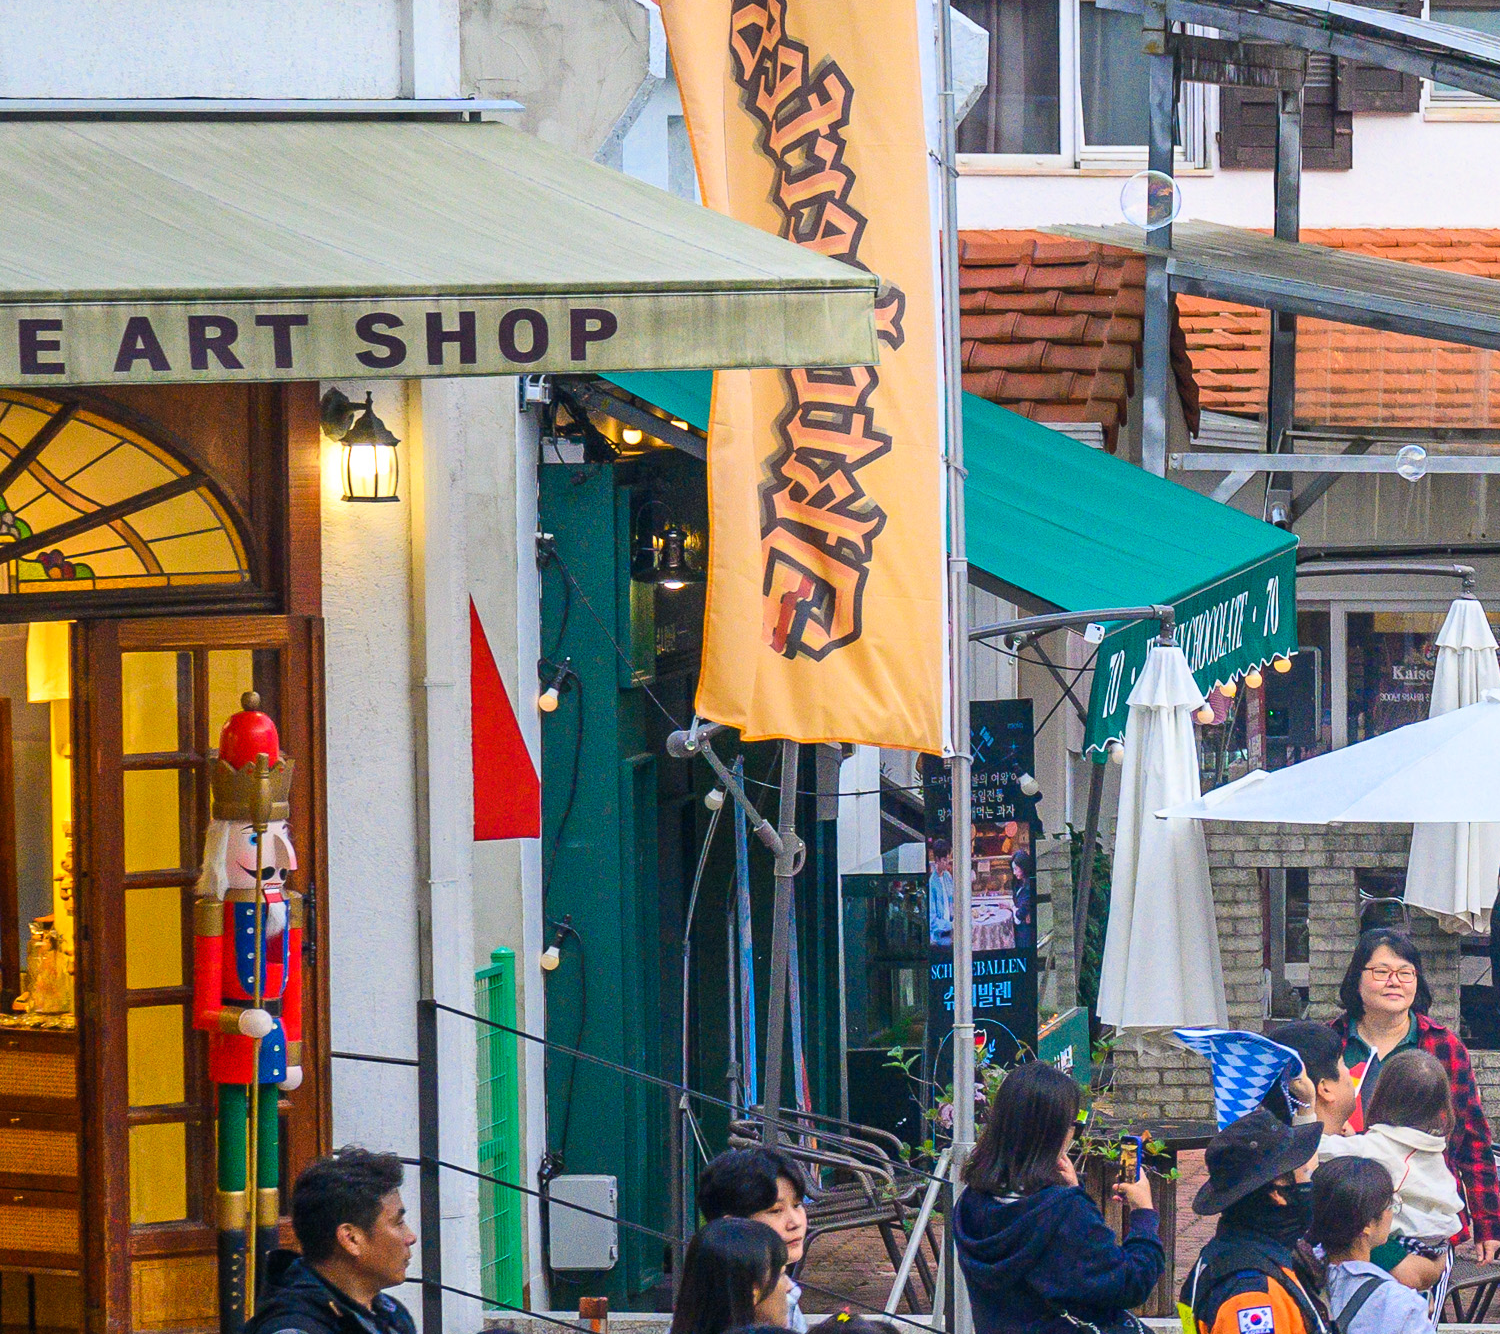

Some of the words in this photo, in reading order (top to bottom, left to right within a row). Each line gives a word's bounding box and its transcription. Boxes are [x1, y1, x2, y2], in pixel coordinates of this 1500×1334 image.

[114, 314, 310, 373] ART
[355, 308, 619, 370] SHOP
[1263, 575, 1280, 637] 70
[1102, 650, 1125, 718] 70
[1392, 666, 1434, 681] Kaise
[930, 957, 1028, 981] SCHEBALLEN
